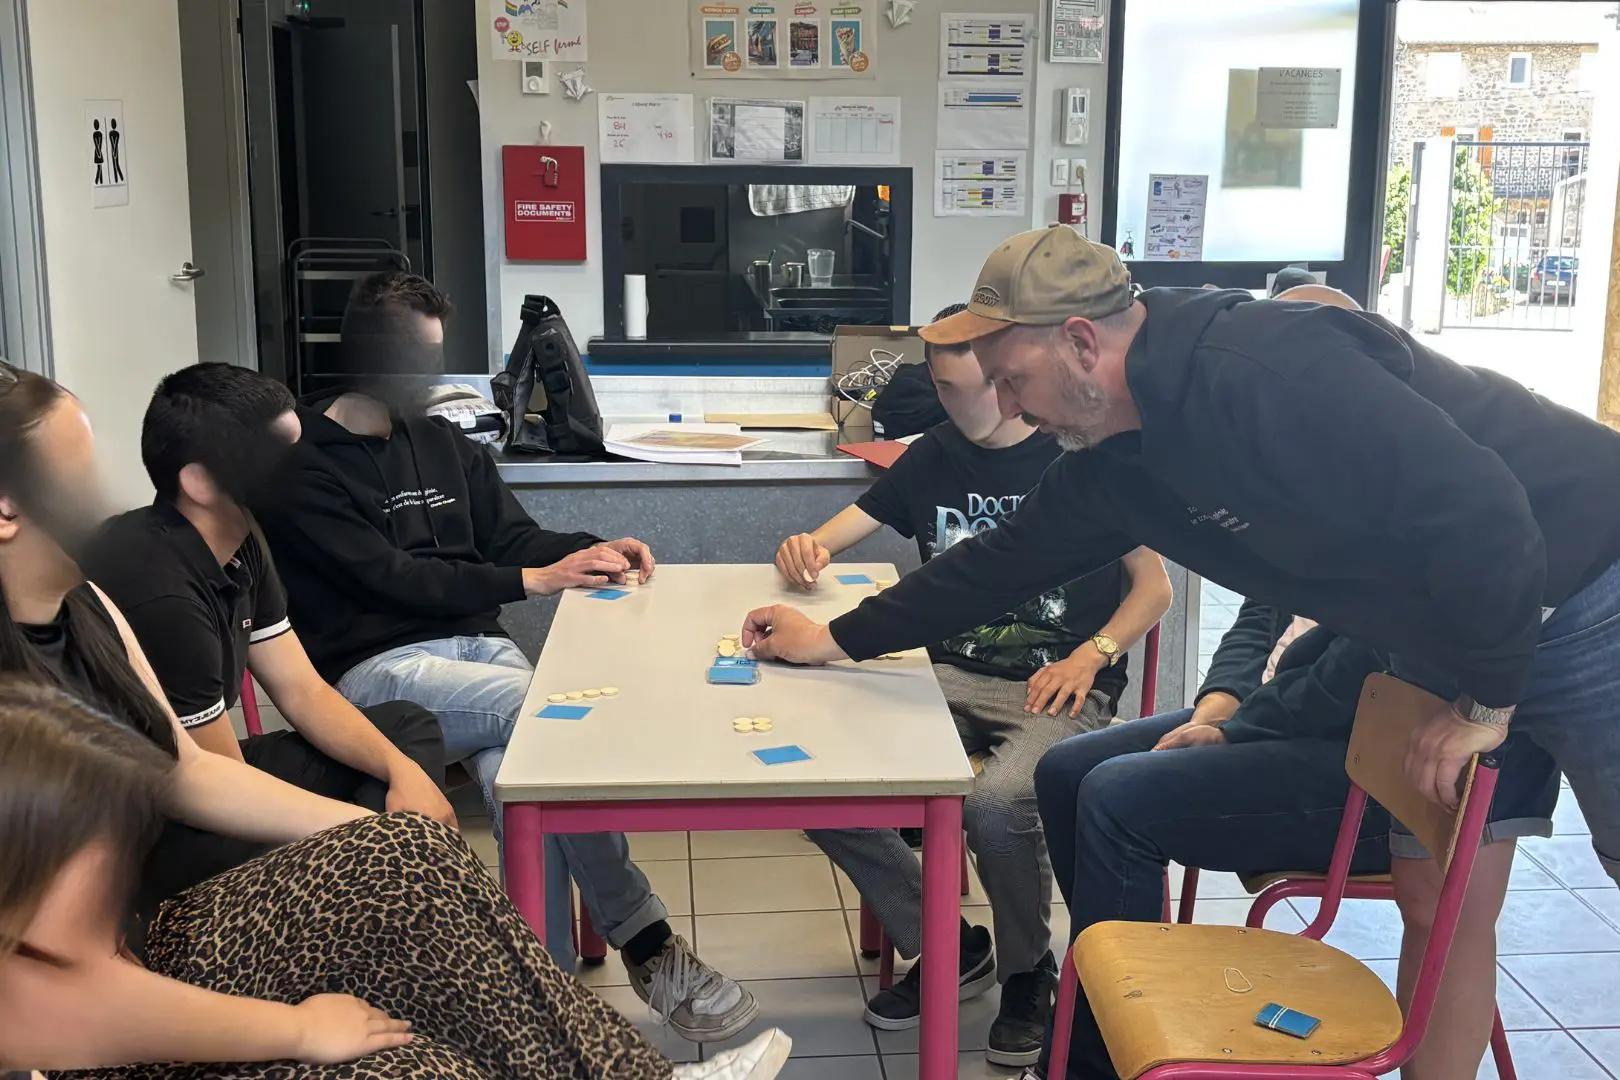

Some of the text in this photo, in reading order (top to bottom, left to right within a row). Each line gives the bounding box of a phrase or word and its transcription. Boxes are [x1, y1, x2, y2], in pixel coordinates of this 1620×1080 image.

[526, 39, 550, 56] SELF
[1279, 69, 1324, 78] VACANCES
[967, 492, 1026, 516] DOCT
